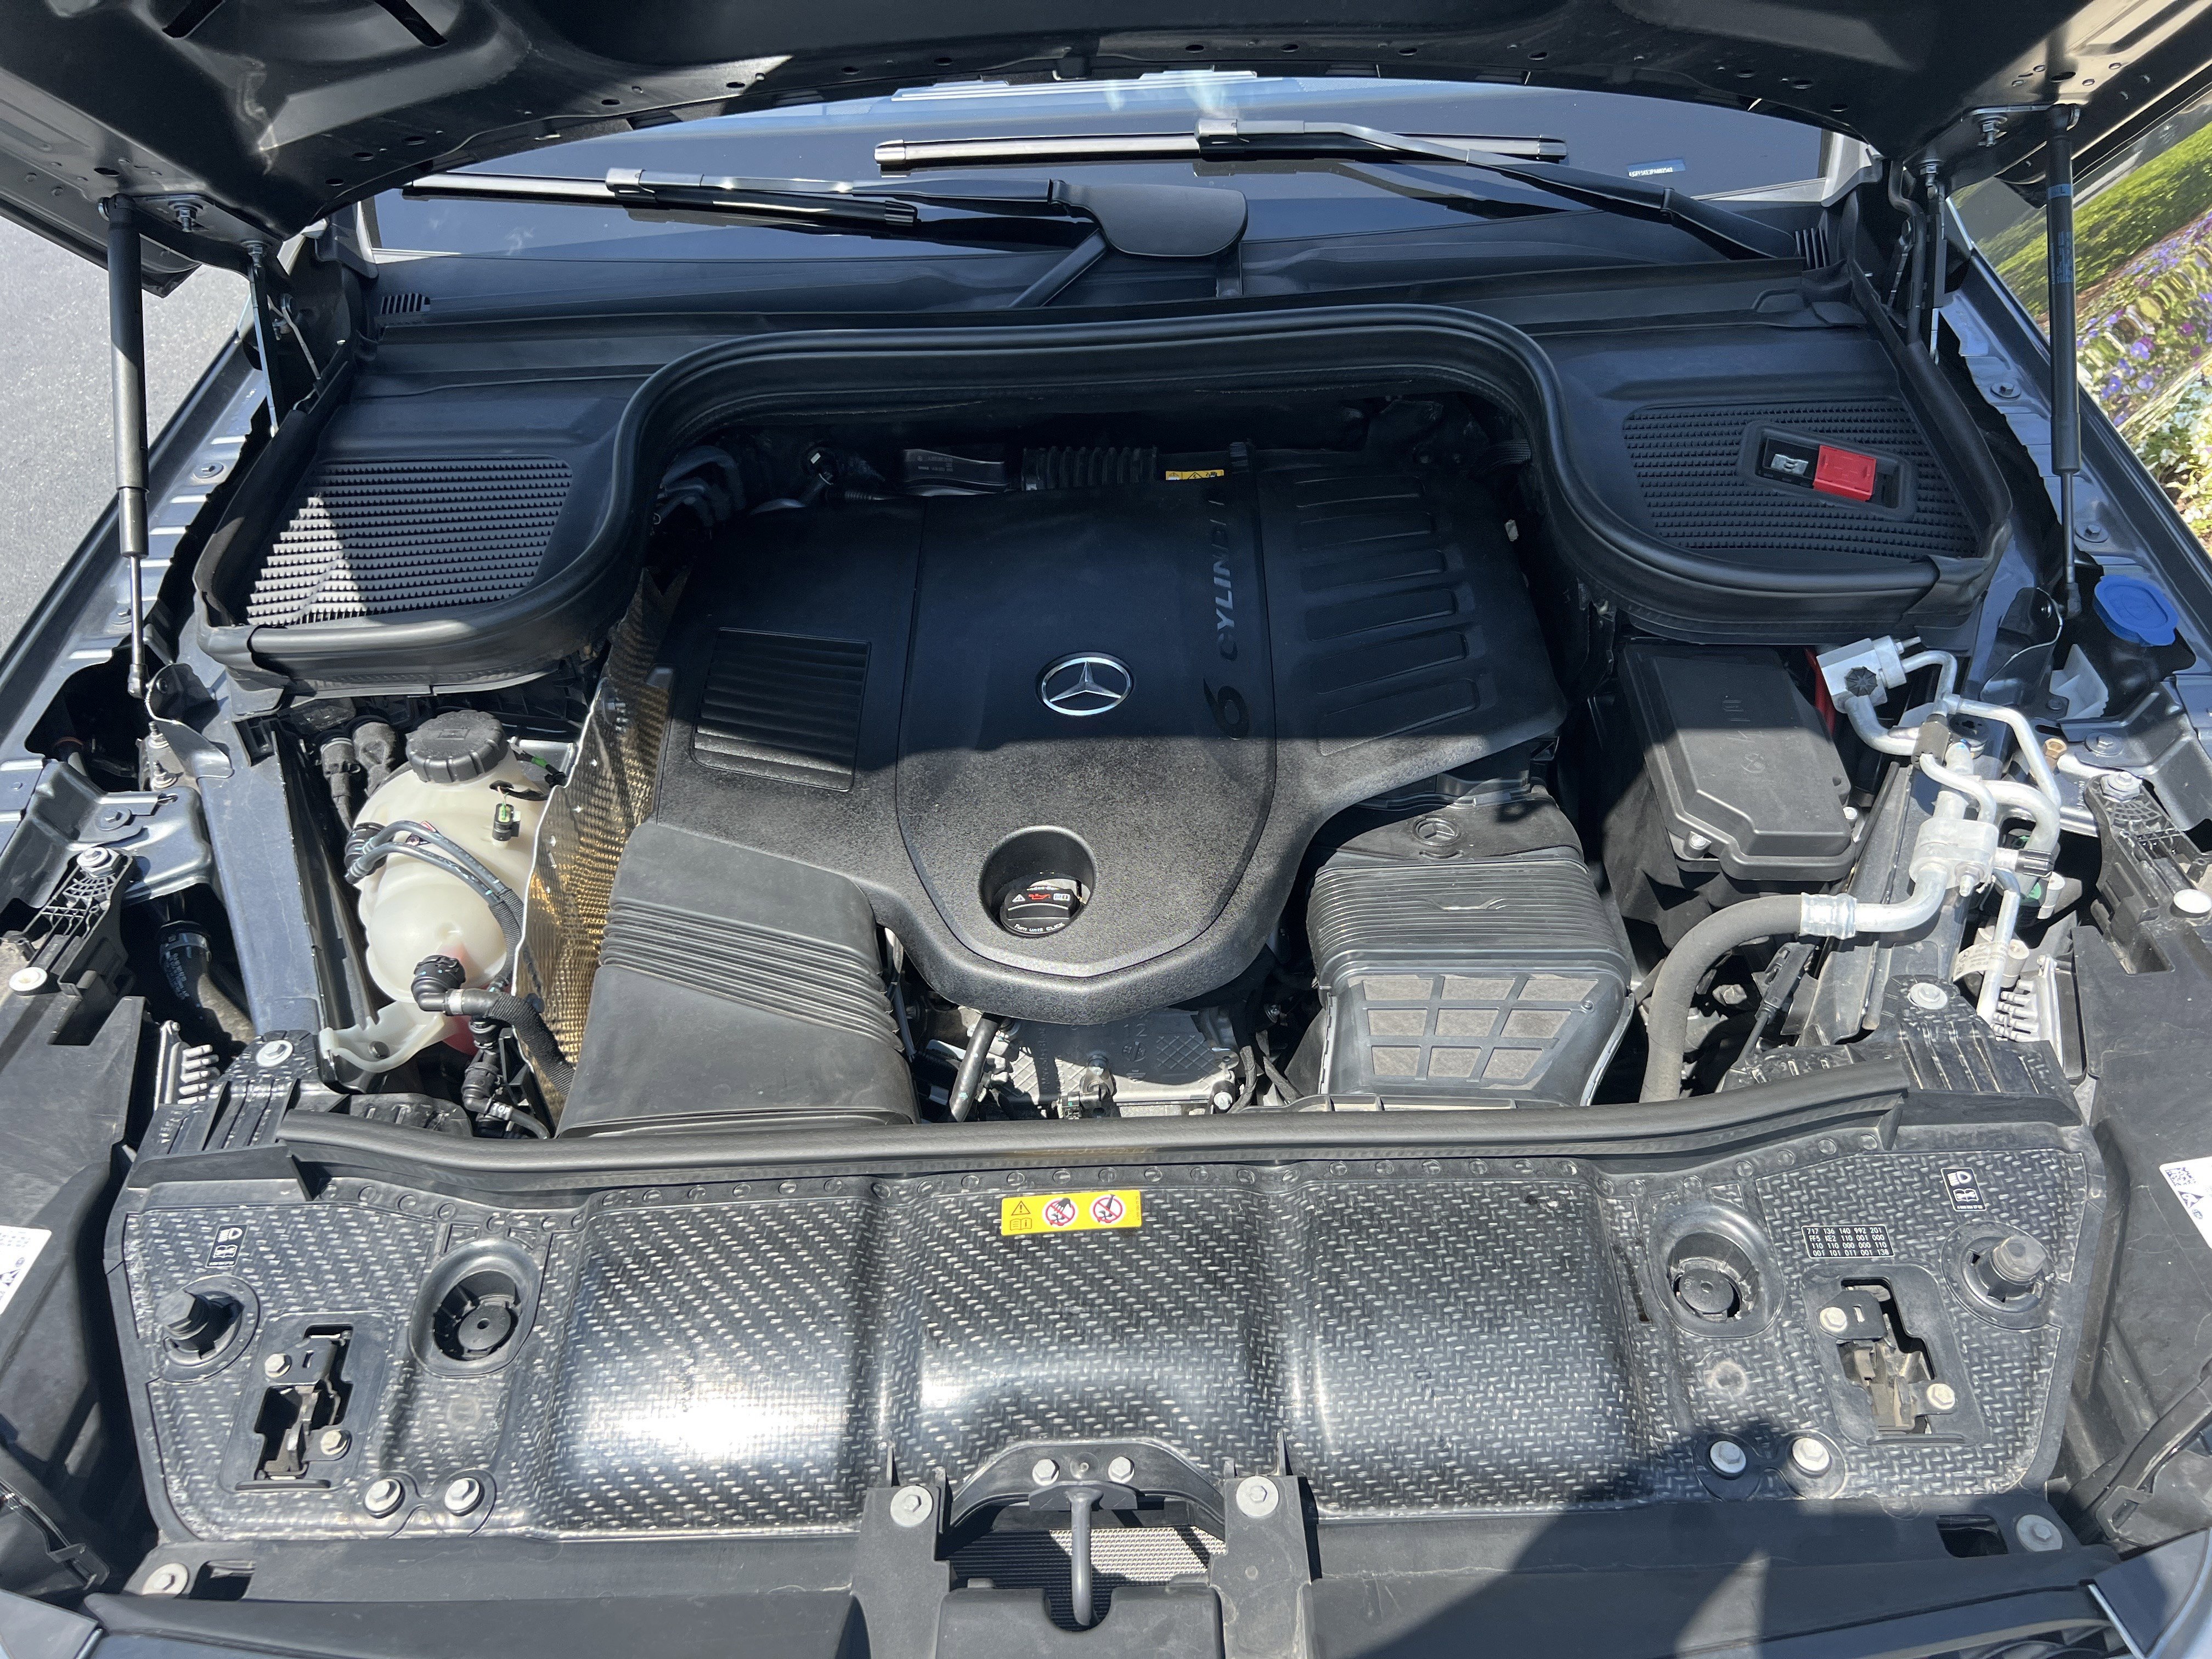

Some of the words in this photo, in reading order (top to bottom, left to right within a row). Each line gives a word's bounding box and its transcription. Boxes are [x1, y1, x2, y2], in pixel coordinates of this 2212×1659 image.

[1014, 923, 1028, 932] Turn
[1046, 922, 1065, 931] CLICK
[493, 1103, 511, 1114] TOP
